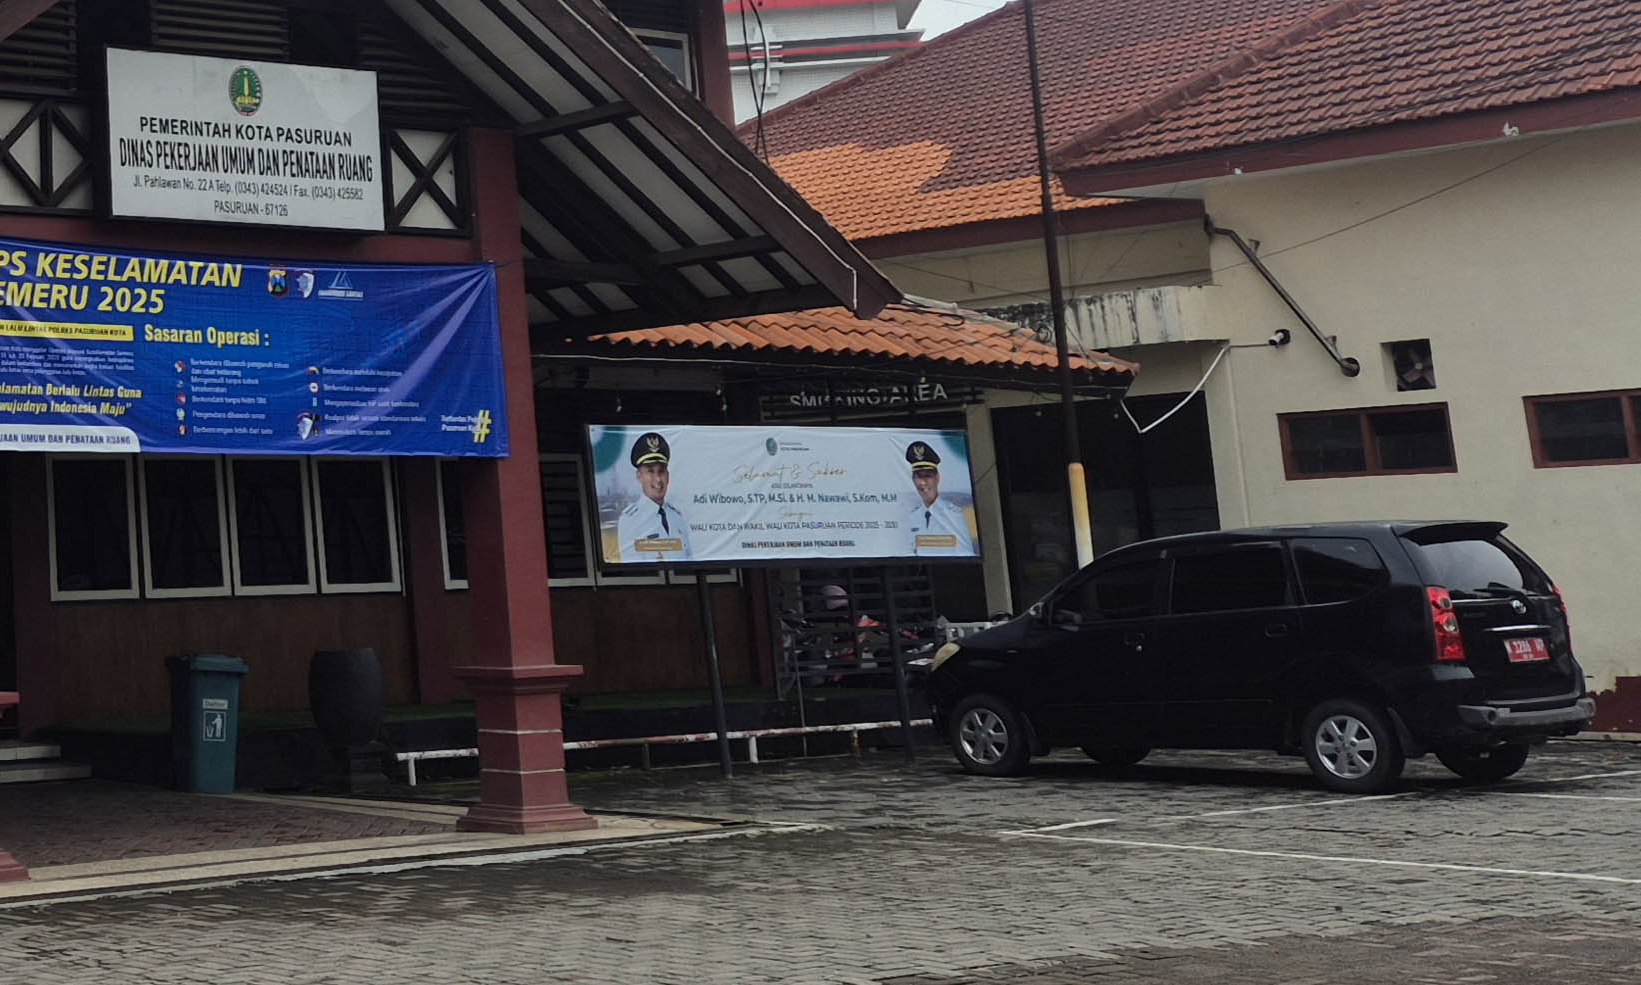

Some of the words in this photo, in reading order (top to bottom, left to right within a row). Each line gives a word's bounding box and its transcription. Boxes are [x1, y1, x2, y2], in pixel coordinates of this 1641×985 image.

[140, 116, 232, 139] PEMERINTAH
[235, 123, 274, 143] KOTA
[276, 126, 352, 147] PASURUAN
[119, 137, 154, 168] DINAS
[155, 140, 219, 173] PEKERJAAN
[221, 145, 256, 176] UMUM
[258, 147, 280, 177] DAN
[282, 149, 336, 181] PENATAAN
[338, 153, 373, 183] RUANG
[144, 174, 181, 190] Pahlawan
[183, 177, 196, 190] No.
[197, 178, 208, 191] 22
[235, 181, 260, 198] (0343)
[260, 182, 288, 196] 424524
[311, 185, 336, 200] (0343)
[214, 199, 259, 215] PASURUAN
[36, 251, 243, 288] KESELAMATAN
[97, 286, 166, 314] 2025
[144, 323, 203, 344] Sasaran
[206, 325, 260, 349] Operasi
[46, 383, 80, 398] Berlalu
[83, 384, 115, 399] Lintas
[117, 385, 142, 399] Guna
[50, 400, 97, 414] Indonesia
[20, 433, 46, 443] UMUM
[65, 434, 105, 445] PENATAAN
[693, 494, 708, 504] Adi
[709, 493, 746, 505] Wibowo,
